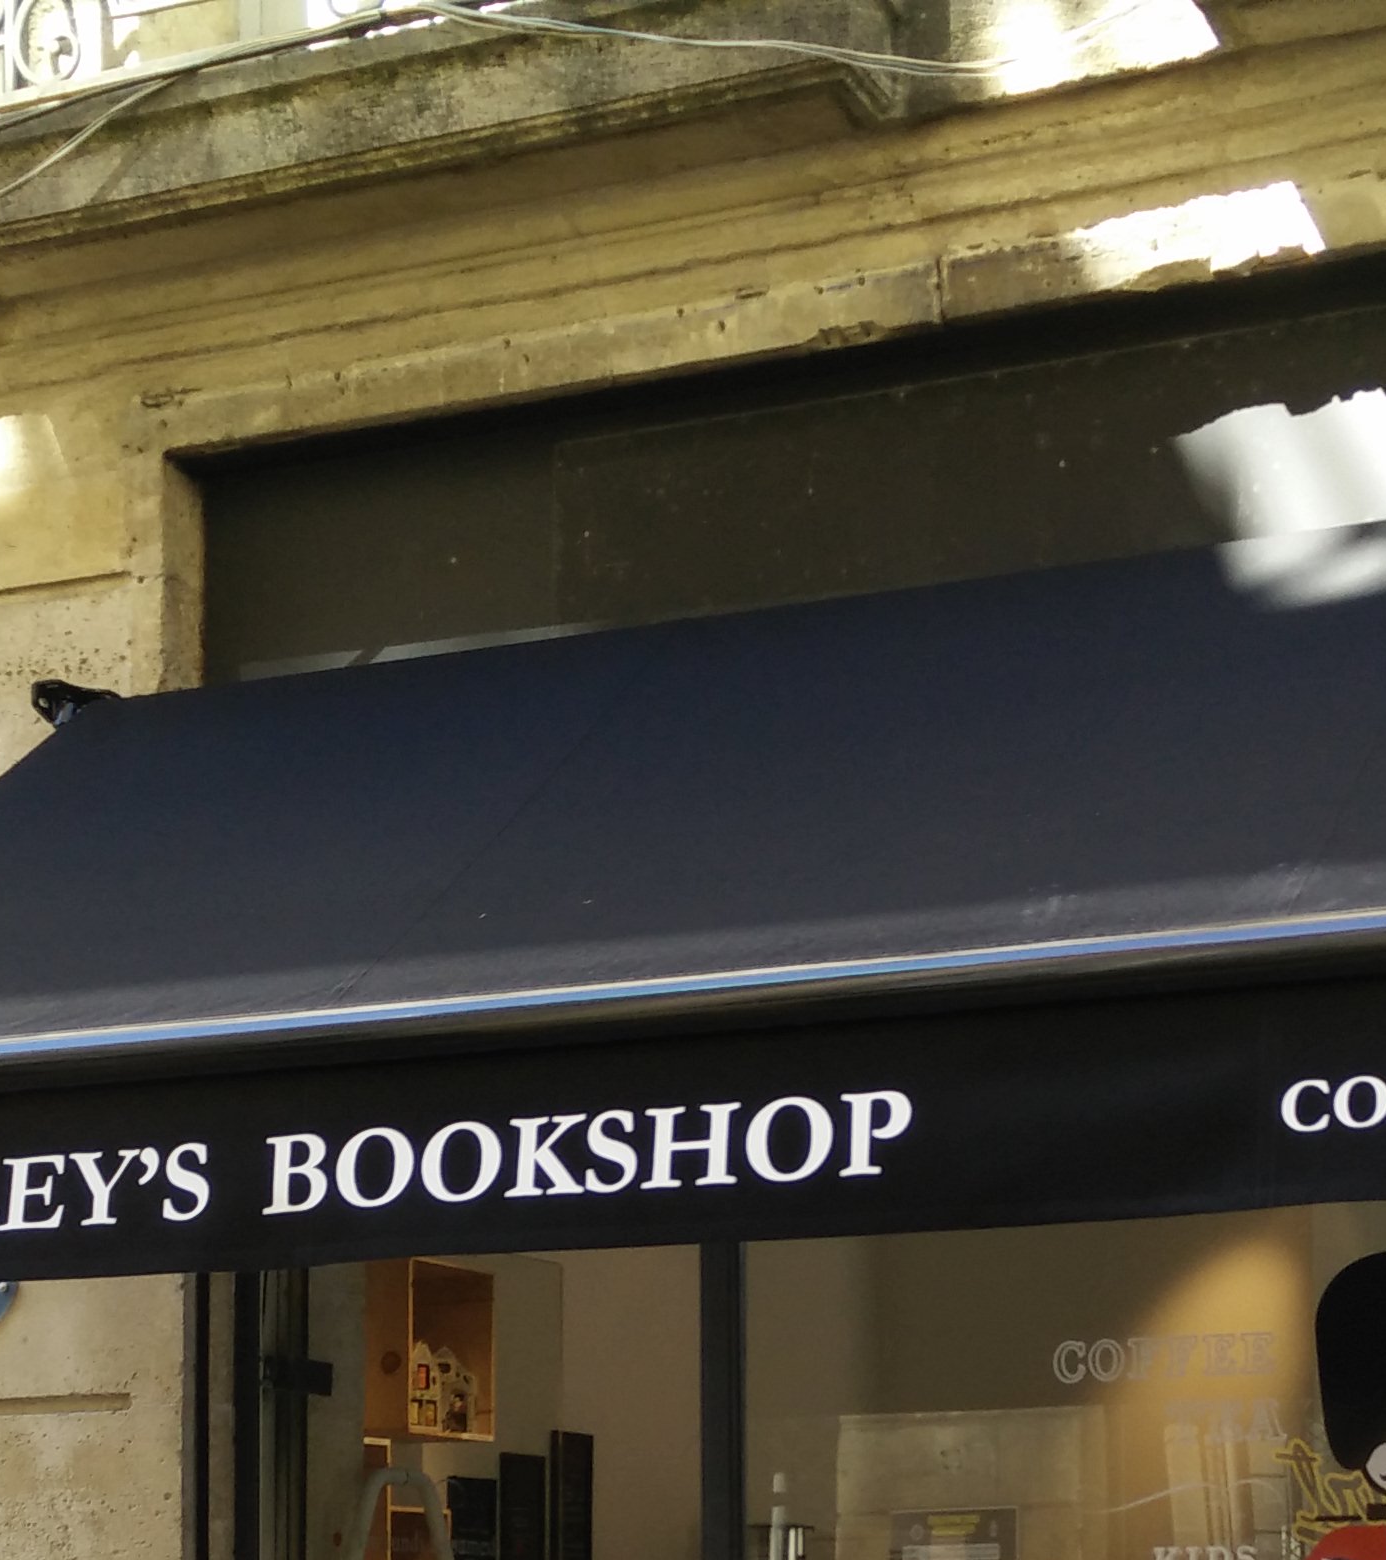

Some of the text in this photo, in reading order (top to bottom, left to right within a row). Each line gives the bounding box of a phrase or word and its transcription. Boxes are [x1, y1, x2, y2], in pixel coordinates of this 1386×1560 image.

[261, 1090, 913, 1216] BOOKSHOP
[1052, 1332, 1276, 1384] COFFEE
[1165, 1398, 1288, 1441] TEA
